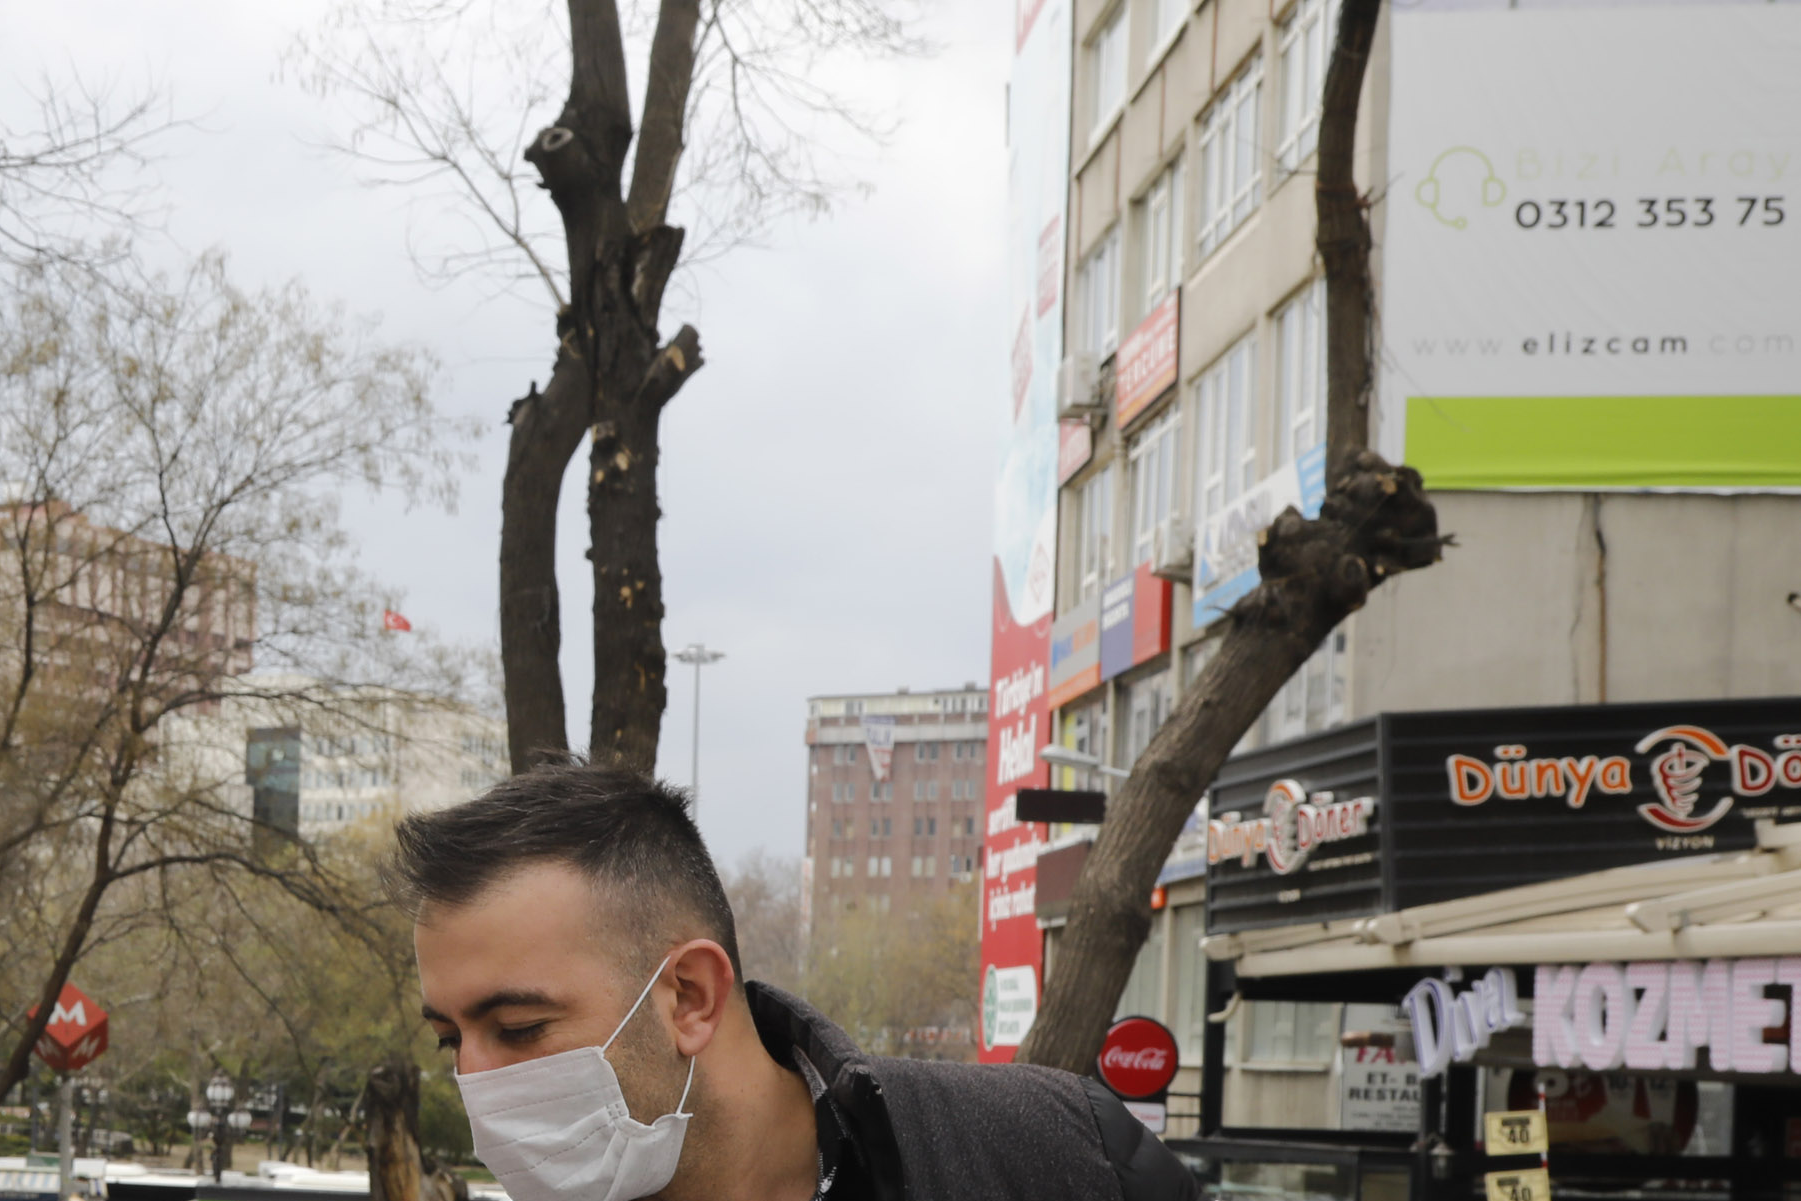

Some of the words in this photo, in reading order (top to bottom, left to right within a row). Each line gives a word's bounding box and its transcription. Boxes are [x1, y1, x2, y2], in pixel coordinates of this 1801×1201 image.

[1515, 199, 1616, 229] 0312
[1637, 198, 1715, 228] 353
[1737, 197, 1785, 227] 75
[1447, 744, 1632, 809] Dünya
[1208, 811, 1272, 868] Dünya
[1298, 791, 1374, 849] Döner
[1508, 1129, 1530, 1145] 40
